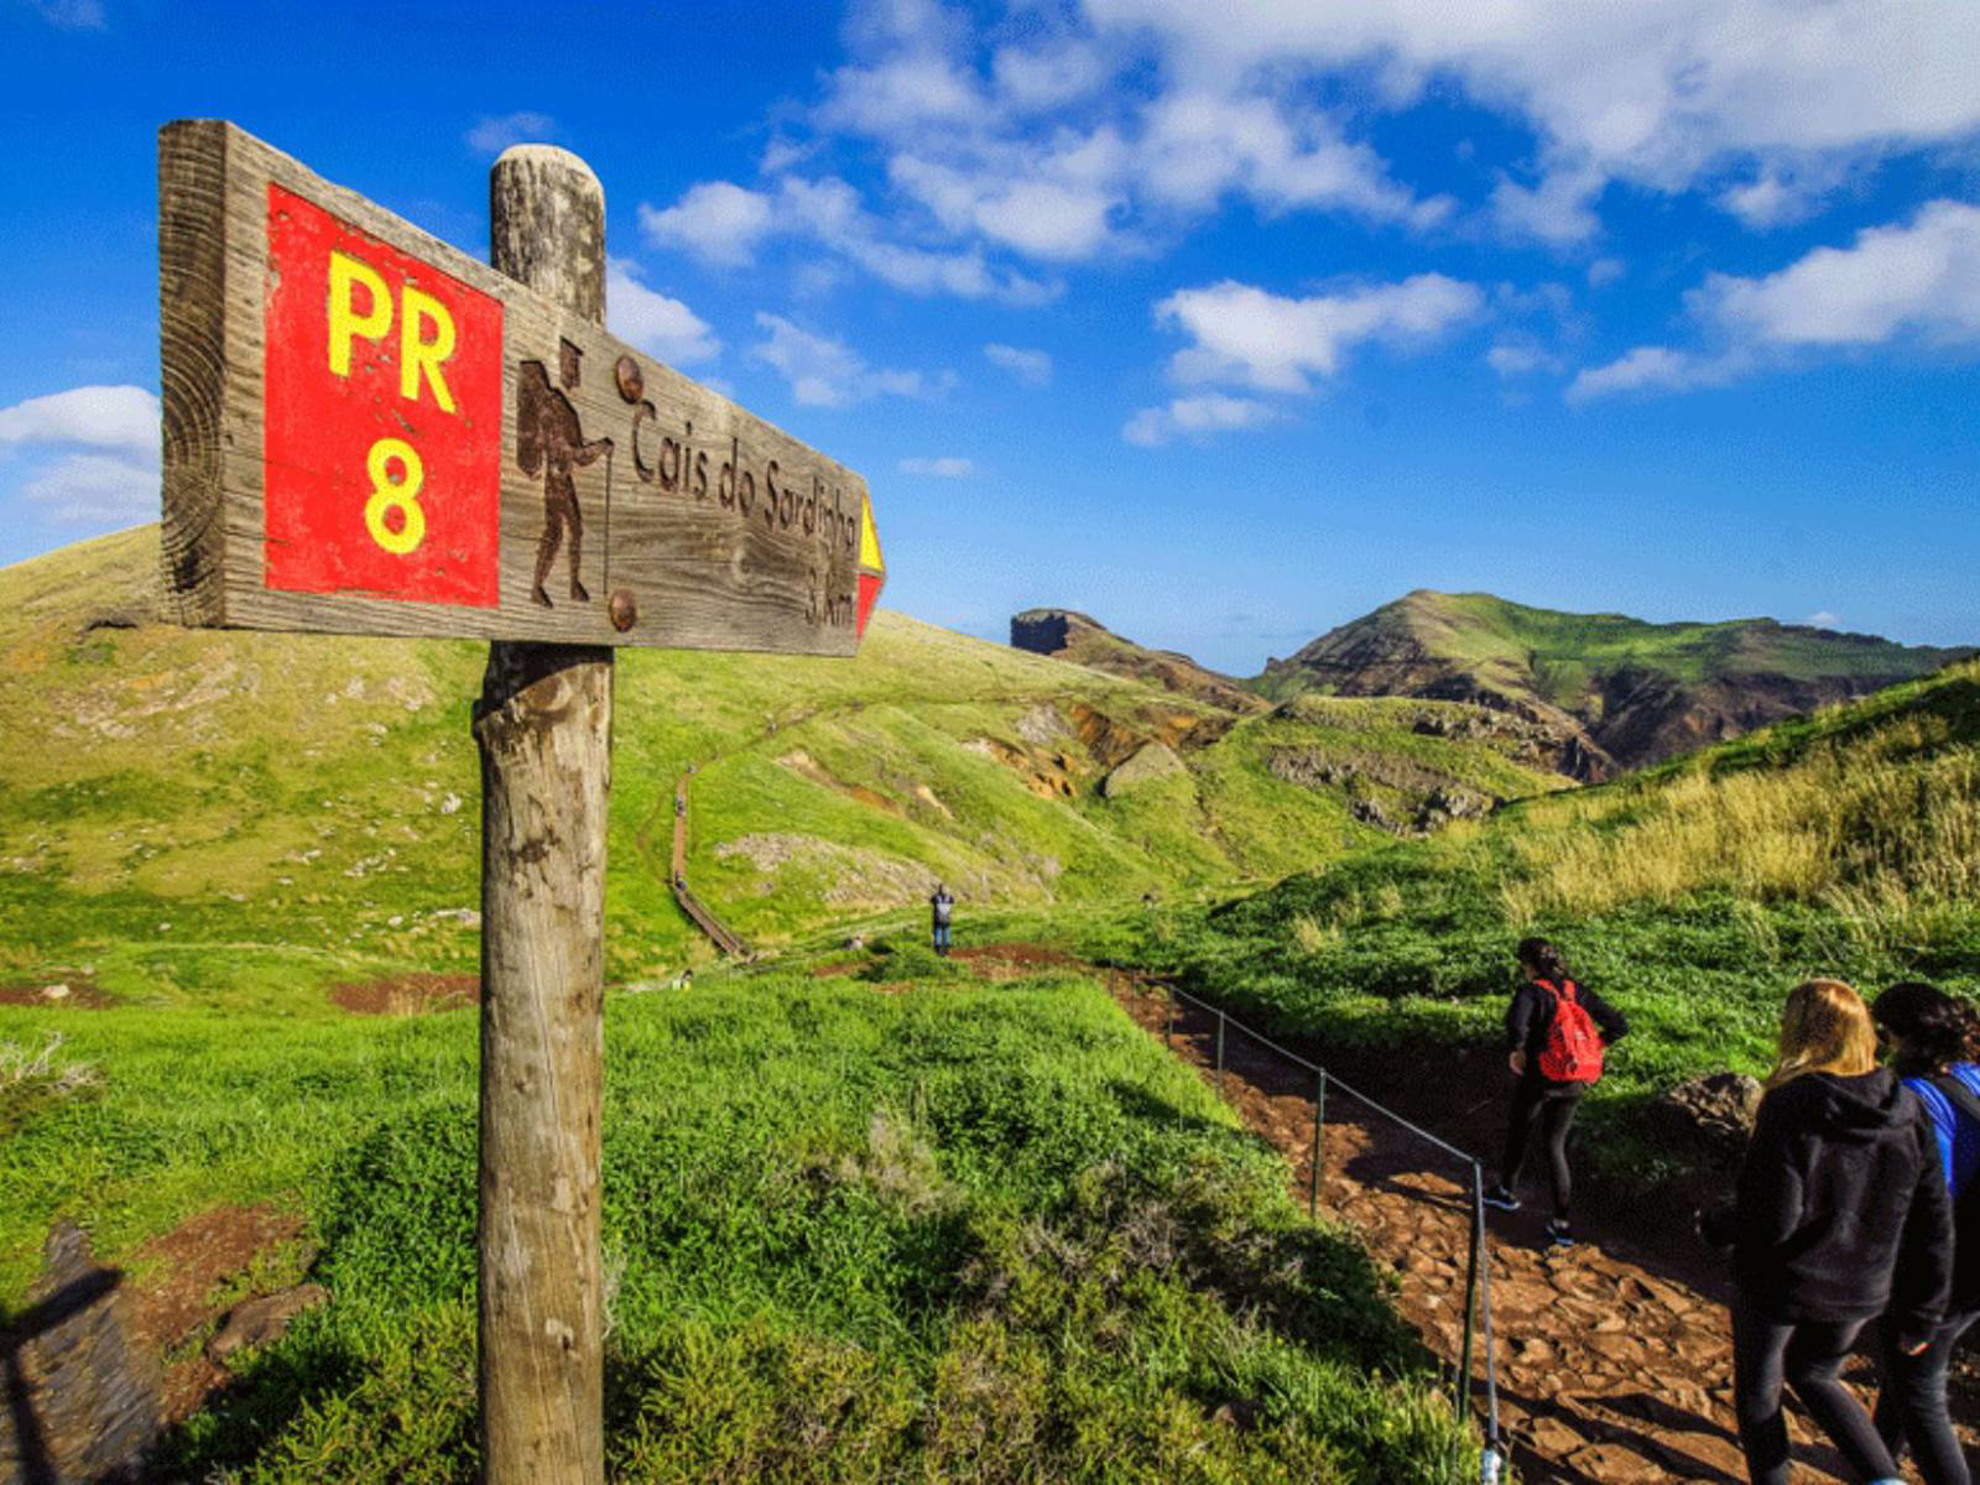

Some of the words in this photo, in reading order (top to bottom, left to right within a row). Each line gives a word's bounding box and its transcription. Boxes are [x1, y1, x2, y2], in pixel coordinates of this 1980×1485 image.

[328, 250, 457, 415] PR
[364, 437, 426, 555] 8
[632, 399, 708, 501] Cais
[718, 436, 755, 518] do
[763, 460, 855, 553] Sardinha
